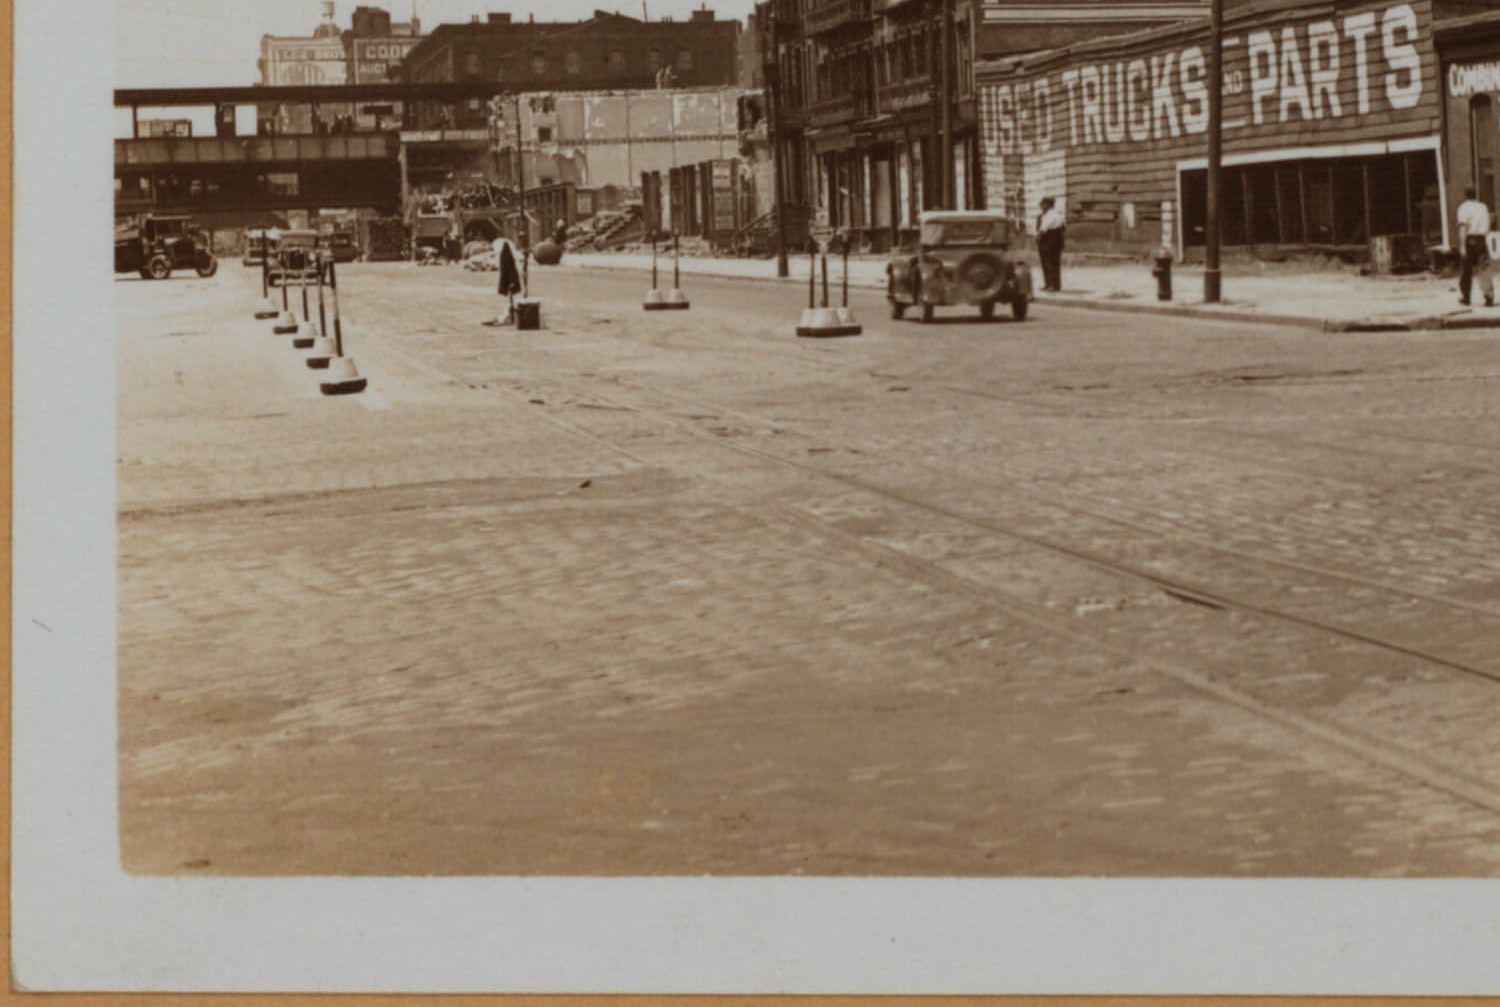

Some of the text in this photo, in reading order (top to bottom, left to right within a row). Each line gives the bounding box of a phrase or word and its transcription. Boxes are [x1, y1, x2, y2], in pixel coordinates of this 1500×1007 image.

[981, 3, 1423, 154] USED TRUCKS ND PARTS
